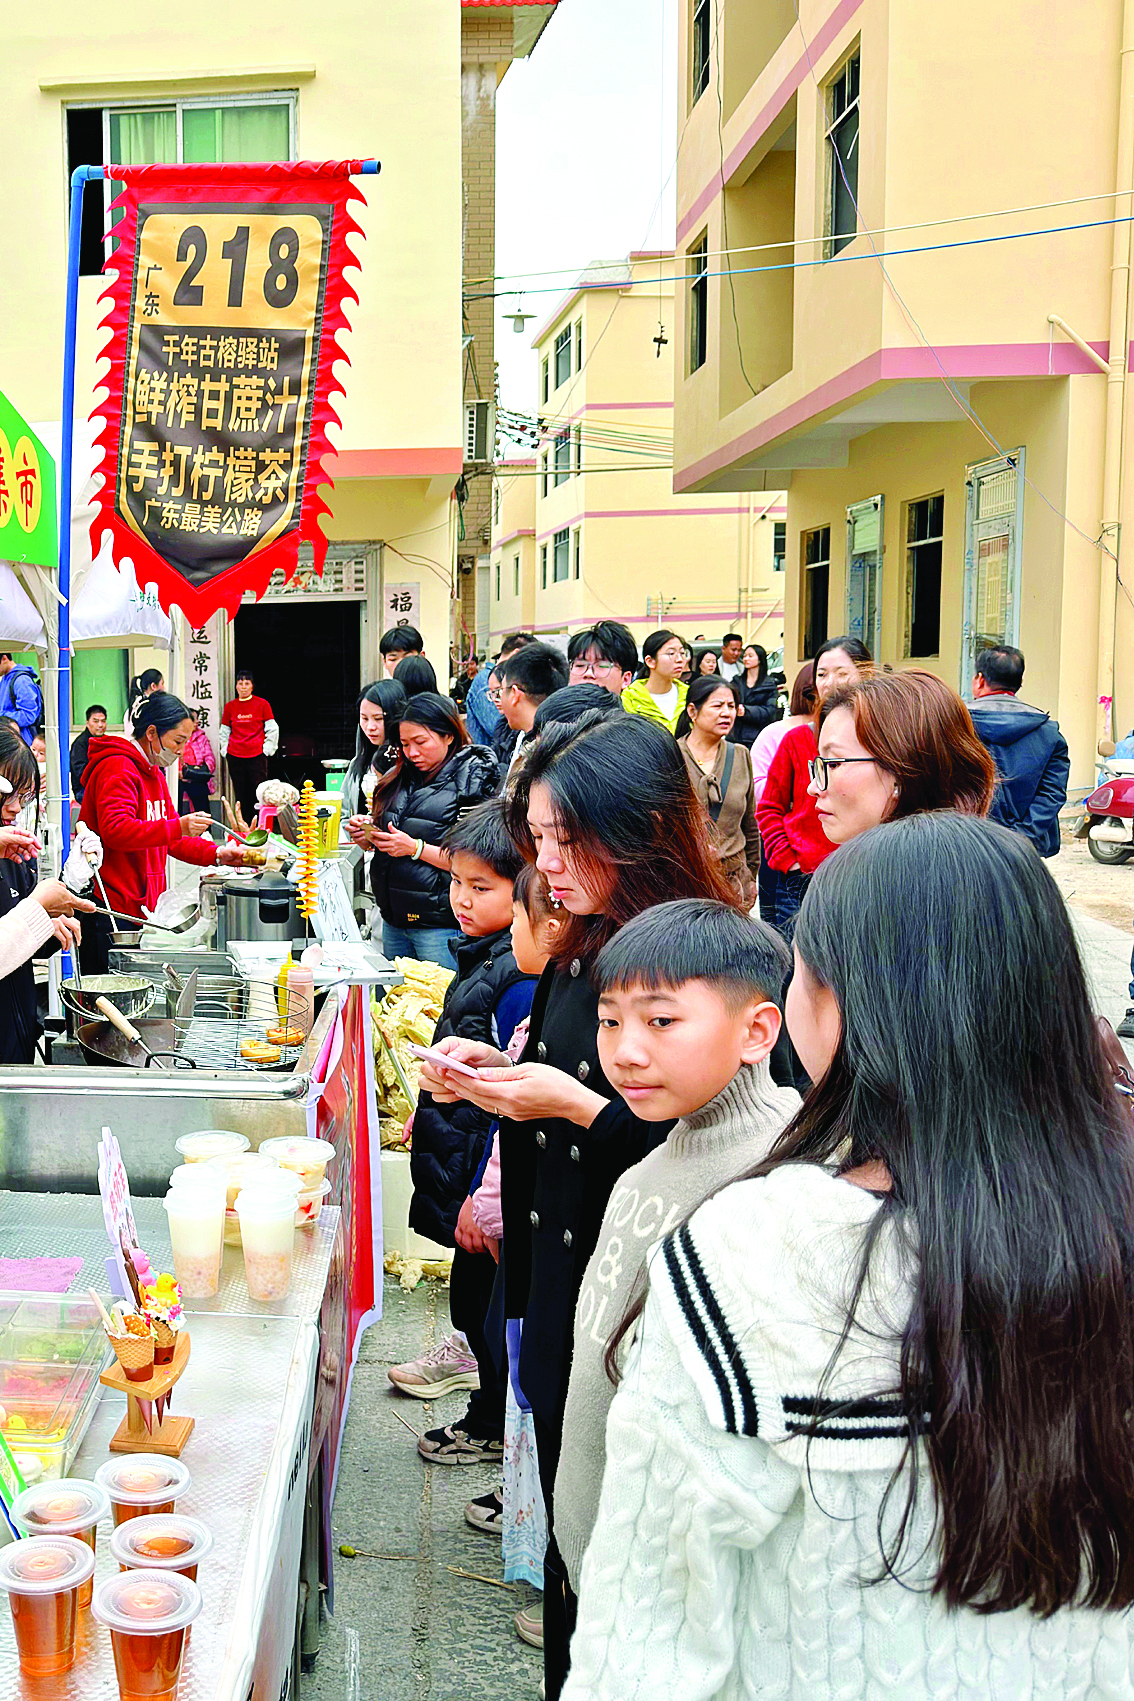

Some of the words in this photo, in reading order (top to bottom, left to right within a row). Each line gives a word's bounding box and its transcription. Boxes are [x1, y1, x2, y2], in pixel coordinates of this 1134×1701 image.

[142, 264, 163, 317] 广东
[173, 225, 300, 309] 218
[161, 334, 280, 371] 千年古榕驿站
[134, 368, 298, 434] 鲜榨甘蔗汁
[127, 440, 291, 504] 手打柠檬茶
[142, 497, 263, 538] 广东最美公路
